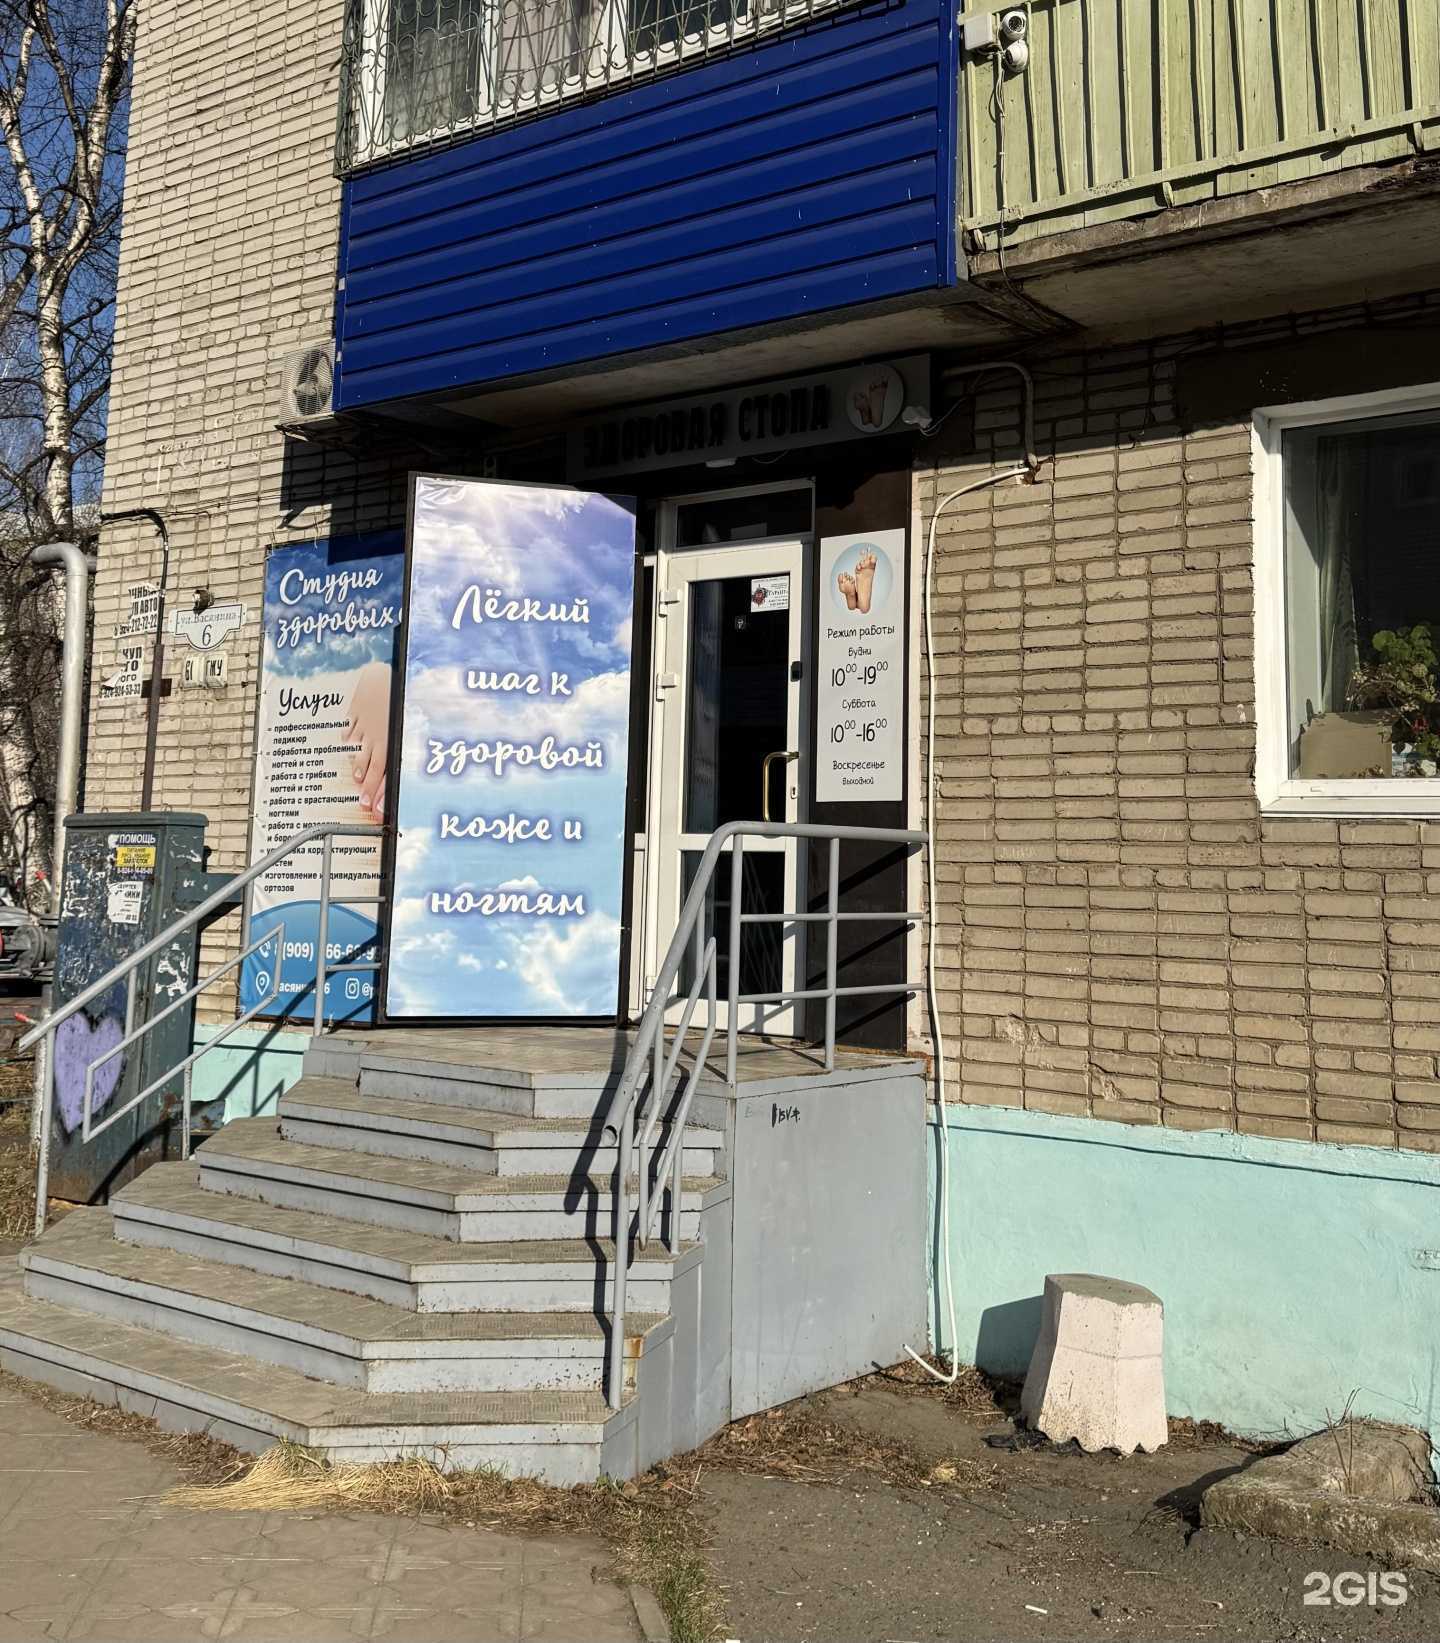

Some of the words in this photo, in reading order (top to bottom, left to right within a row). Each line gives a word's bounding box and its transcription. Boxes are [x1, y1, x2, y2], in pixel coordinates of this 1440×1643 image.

[584, 402, 725, 468] ЗДОРОВАЯ
[739, 384, 829, 442] СТОПА
[280, 568, 383, 605] Студия
[140, 597, 157, 614] АВТО
[452, 585, 590, 629] Лёгкий
[277, 602, 394, 648] здоровых
[202, 624, 212, 646] 6
[827, 628, 857, 639] Режим
[859, 625, 895, 640] работы
[848, 647, 872, 659] Будни
[467, 671, 541, 694] шаг
[551, 672, 572, 695] к
[279, 688, 344, 716] Услуги
[842, 699, 876, 711] Суббота
[274, 719, 350, 734] профессиональный
[273, 736, 307, 745] педикюр
[272, 747, 311, 757] обработка
[314, 745, 362, 755] проблемных
[426, 736, 603, 775] здоровой
[272, 759, 297, 769] ногтей
[306, 759, 324, 767] стоп
[832, 760, 885, 773] Воскресенье
[271, 772, 297, 782] работа
[305, 770, 337, 780] грибком
[842, 777, 874, 785] Выходной
[270, 784, 295, 793] ногтей
[304, 784, 322, 792] стоп
[269, 796, 295, 806] работа
[304, 795, 360, 805] врастающими
[268, 821, 294, 831] работа
[440, 814, 552, 843] коже
[564, 820, 582, 840] и
[120, 833, 156, 845] ПОМОЩЬ
[265, 871, 317, 881] изготовление
[264, 884, 295, 893] ортозов
[431, 891, 585, 915] ногтям
[282, 942, 314, 961] (909)
[324, 982, 330, 995] 6
